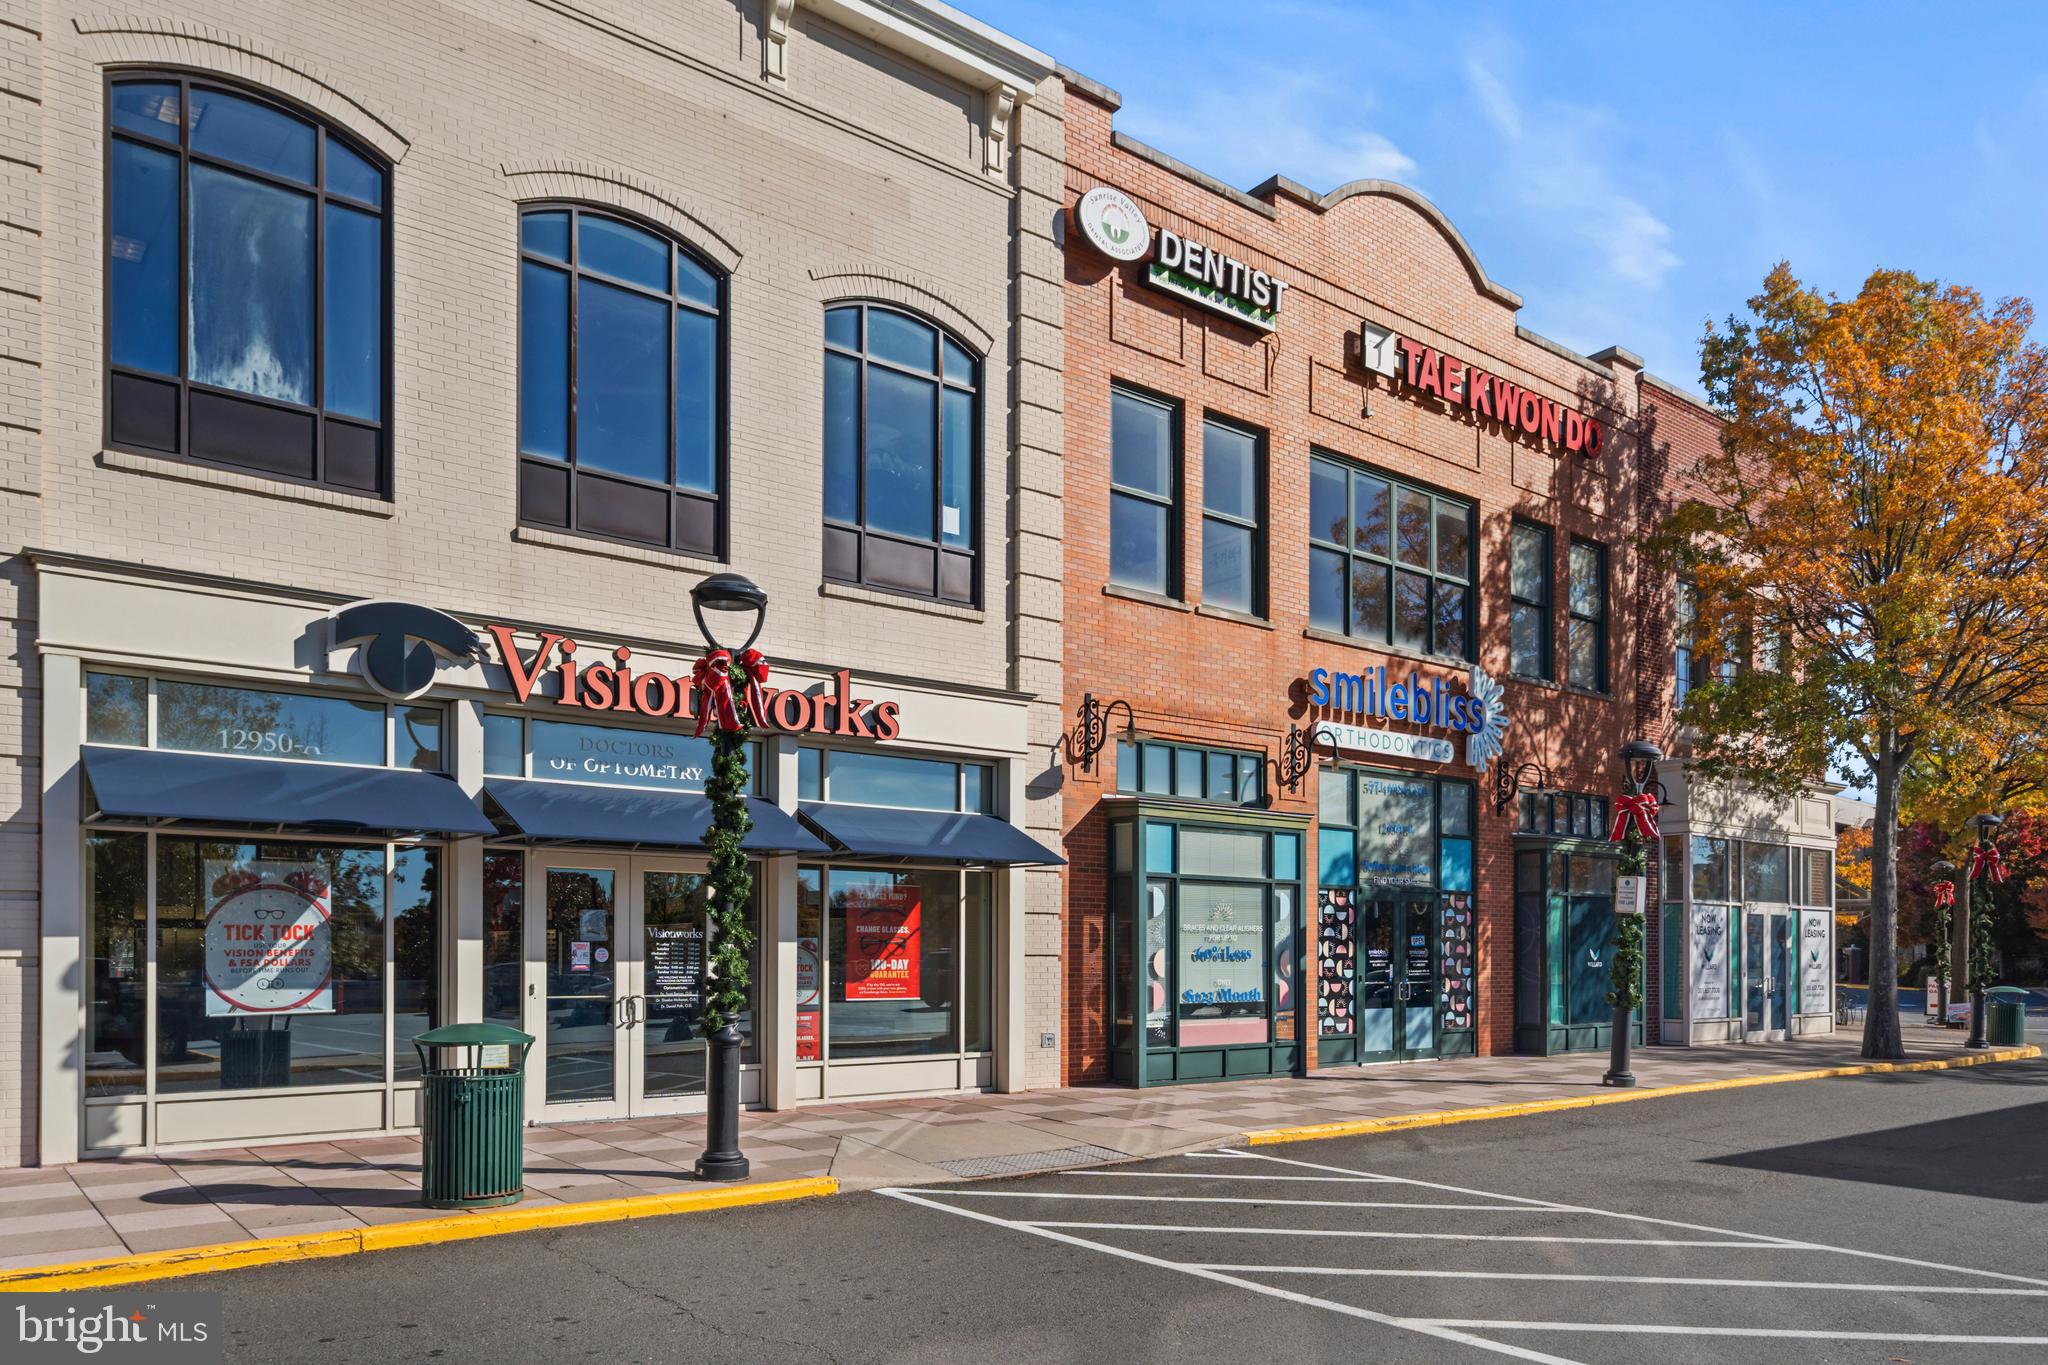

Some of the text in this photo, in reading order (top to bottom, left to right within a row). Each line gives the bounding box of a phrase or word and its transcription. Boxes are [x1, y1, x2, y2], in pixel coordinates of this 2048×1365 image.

[1160, 229, 1289, 313] DENTIST
[1565, 408, 1603, 458] DO
[1309, 665, 1486, 734] smilebliss
[579, 736, 675, 760] DOCTORS
[1320, 724, 1451, 760] ORTHODONTICS
[550, 756, 703, 781] OF OPTOMETRY
[1702, 914, 1717, 923] NOW
[1808, 918, 1822, 927] NOW
[223, 924, 315, 941] TICK TOCK
[648, 927, 704, 939] Visionworks
[856, 925, 881, 933] CHANGE
[1696, 926, 1722, 936] LEASING
[1804, 929, 1826, 938] LEASING
[223, 949, 315, 958] VISION BENEFITS
[228, 958, 312, 968] & FSA DOLLARS
[870, 958, 909, 971] 100-DAY
[870, 970, 909, 979] GUARANTEE
